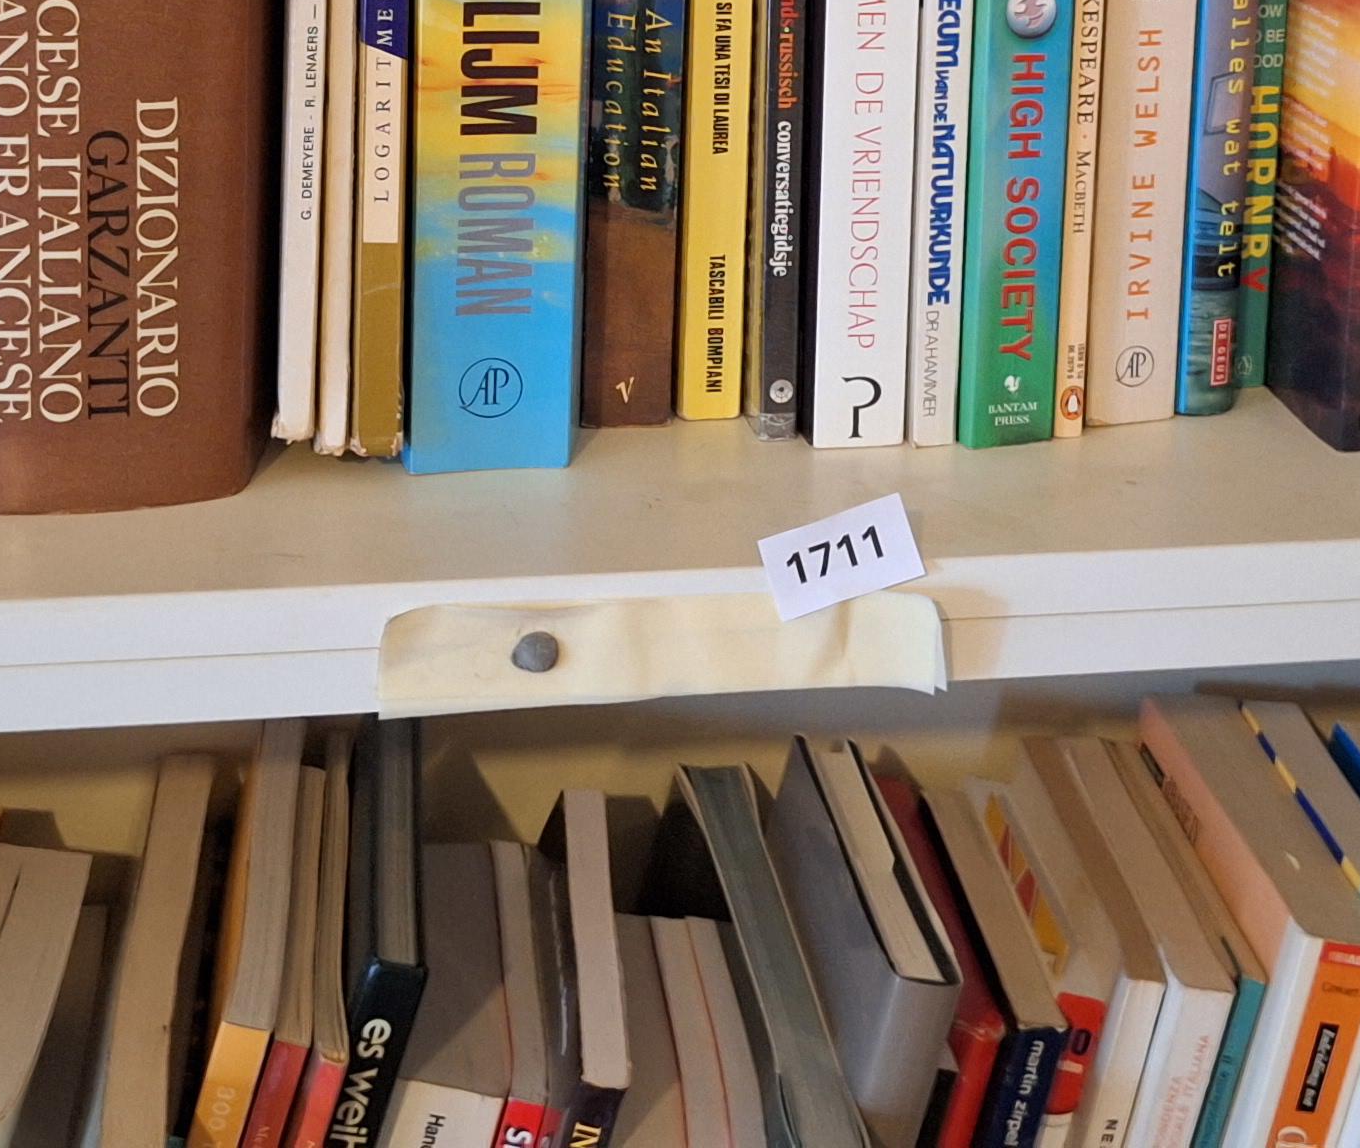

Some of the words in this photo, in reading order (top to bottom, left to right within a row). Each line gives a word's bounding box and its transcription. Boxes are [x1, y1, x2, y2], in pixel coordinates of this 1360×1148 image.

[305, 25, 319, 91] LENAERS
[459, 2, 542, 137] LIJM
[713, 58, 731, 91] TESI
[714, 35, 732, 57] UNA
[1007, 53, 1048, 160] HIGH
[1133, 28, 1164, 148] WELSH
[301, 126, 316, 200] DEMEYERE
[711, 104, 729, 156] LAUREA
[1222, 118, 1241, 177] wat
[927, 123, 956, 306] NATUURKUNDE
[1073, 149, 1093, 234] MACBETH
[135, 97, 181, 421] DIZIONARIO
[454, 153, 537, 317] ROMAN
[847, 126, 884, 350] VRIENDSCHAP
[998, 175, 1041, 362] SOCIETY
[1126, 173, 1156, 321] IRVINE
[1216, 200, 1240, 278] telt
[36, 150, 86, 425] ITALIANO
[707, 254, 727, 320] TASCABILI
[705, 327, 724, 394] BOMPIANI
[987, 401, 1039, 415] BANTAM
[993, 414, 1031, 427] PRESS
[786, 525, 884, 585] 1711
[356, 1018, 392, 1060] es
